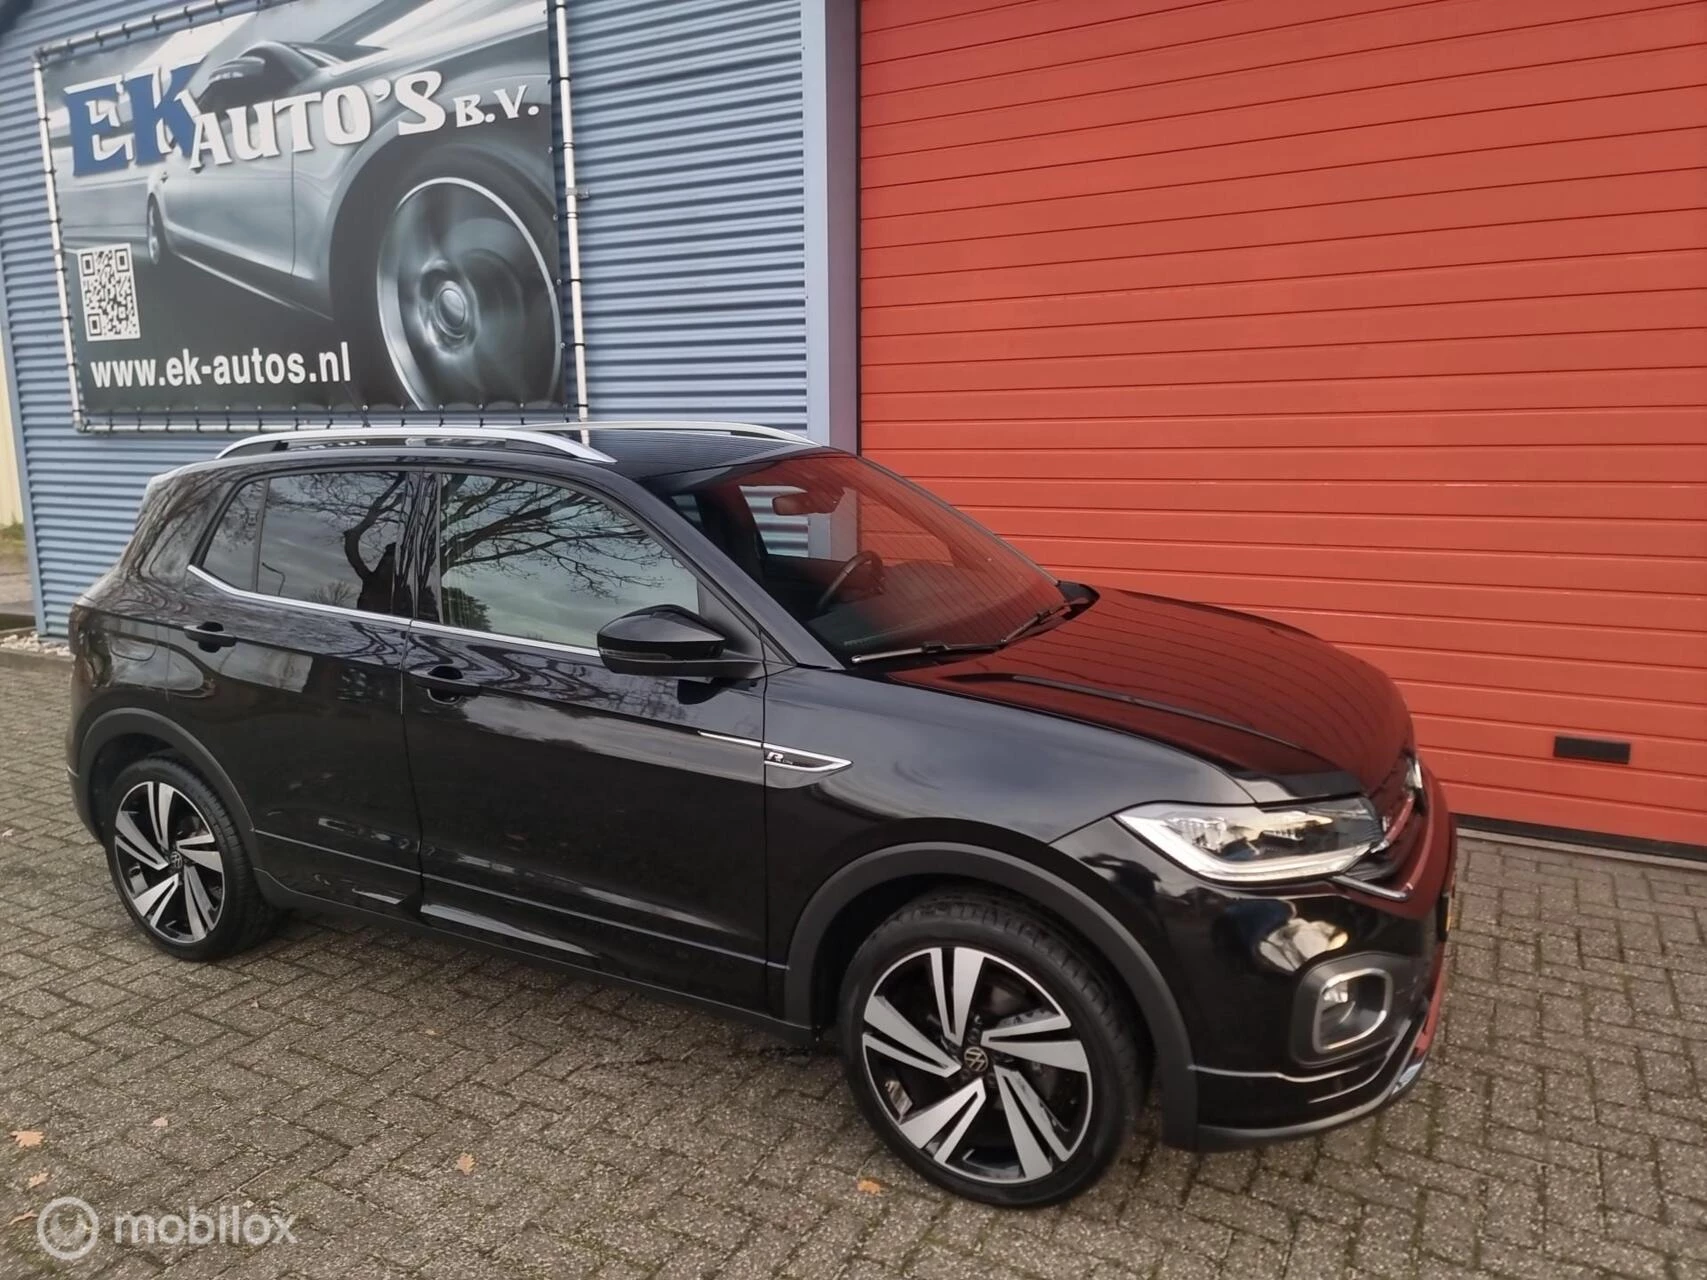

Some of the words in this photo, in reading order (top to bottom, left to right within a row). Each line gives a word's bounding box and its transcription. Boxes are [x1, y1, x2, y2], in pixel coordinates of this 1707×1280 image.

[64, 60, 204, 177] EK
[453, 84, 540, 128] B.V.
[90, 341, 352, 388] www.ek-autos.nl
